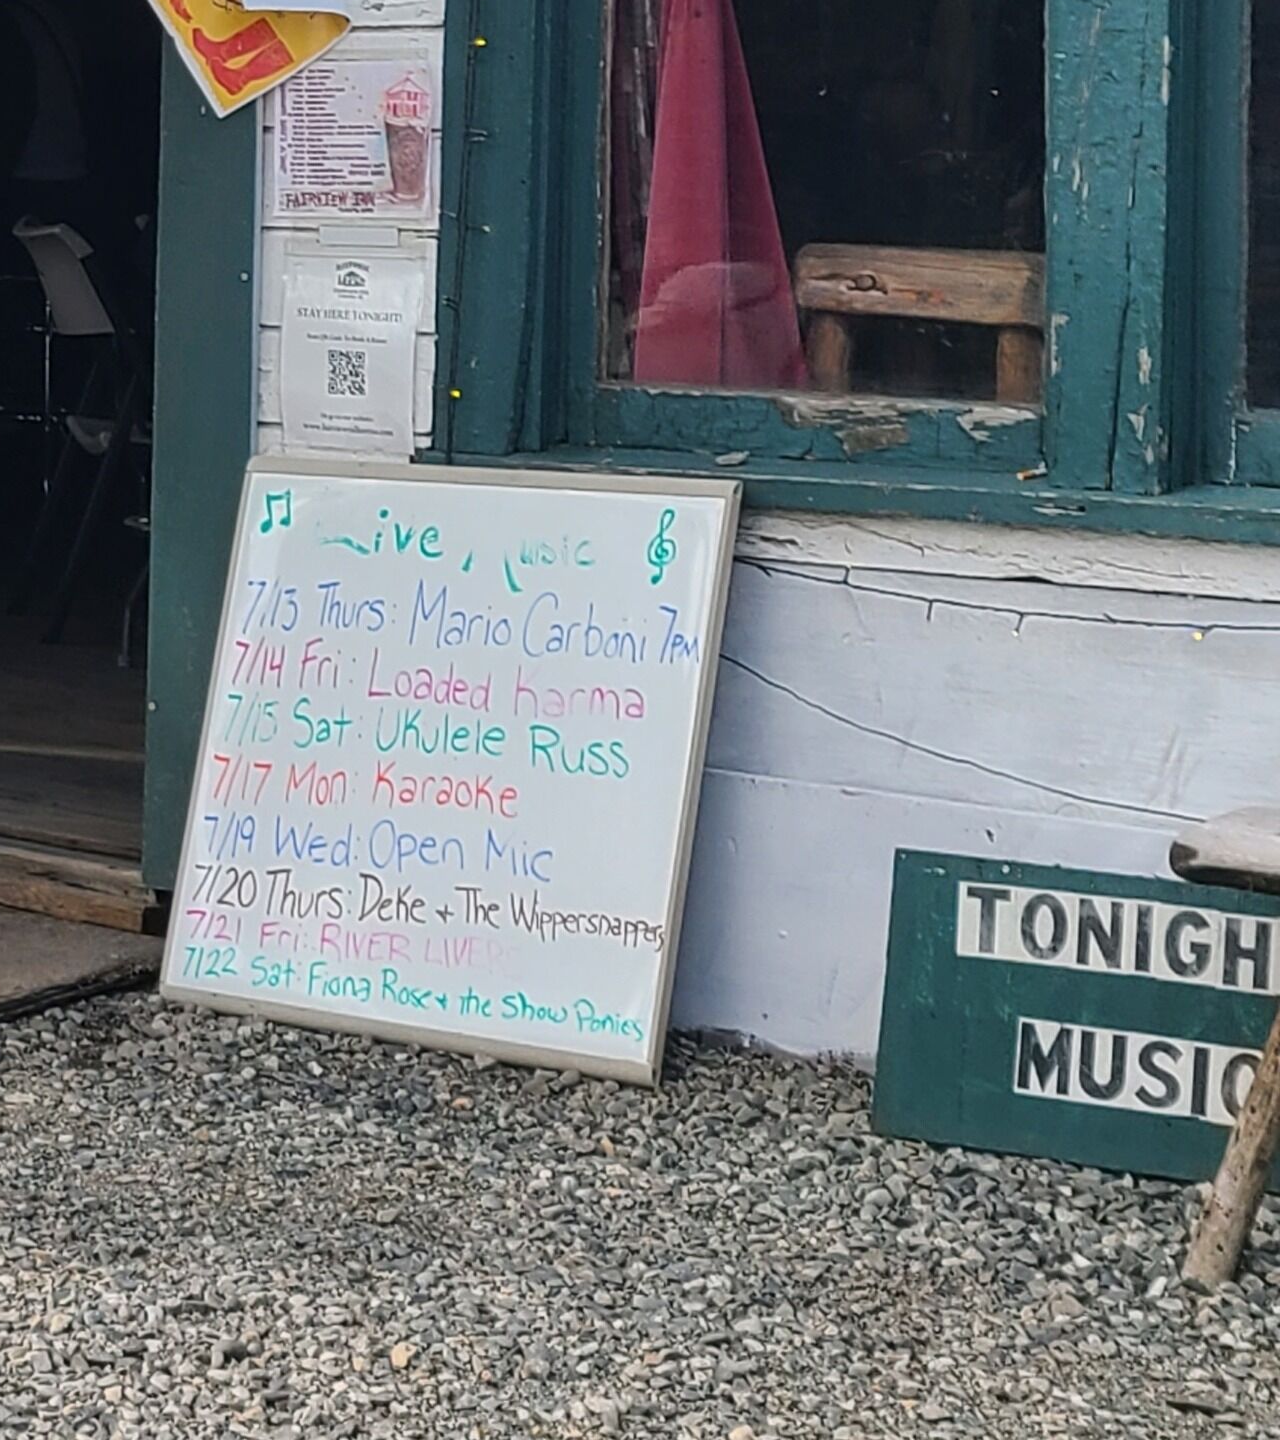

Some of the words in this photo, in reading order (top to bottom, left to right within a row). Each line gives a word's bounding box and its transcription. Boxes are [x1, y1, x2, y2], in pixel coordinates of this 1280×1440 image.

[285, 191, 348, 209] FAIRVIEW
[296, 307, 322, 319] STAY
[324, 309, 351, 320] HERE
[243, 580, 299, 634] 7/13
[408, 578, 512, 649] Mario
[521, 591, 647, 661] Carboni
[230, 636, 287, 688] 7/14
[366, 647, 491, 713] Loaded
[223, 693, 279, 746] 7/15
[530, 723, 630, 779] Russ
[212, 754, 272, 808] 7/17
[203, 814, 255, 859] 7/19
[369, 818, 465, 873] Open
[484, 827, 554, 883] Mic
[191, 864, 258, 910] 7/20
[455, 885, 501, 930] The
[185, 909, 242, 946] 7/21
[319, 923, 414, 963] RIVER
[966, 885, 1272, 991] TONIGH
[182, 945, 238, 978] 7/22
[307, 959, 371, 1003] Fiona
[381, 967, 431, 1010] Rose
[501, 991, 569, 1025] Show
[573, 998, 644, 1043] Ponies
[1017, 1022, 1262, 1120] MUSIC
